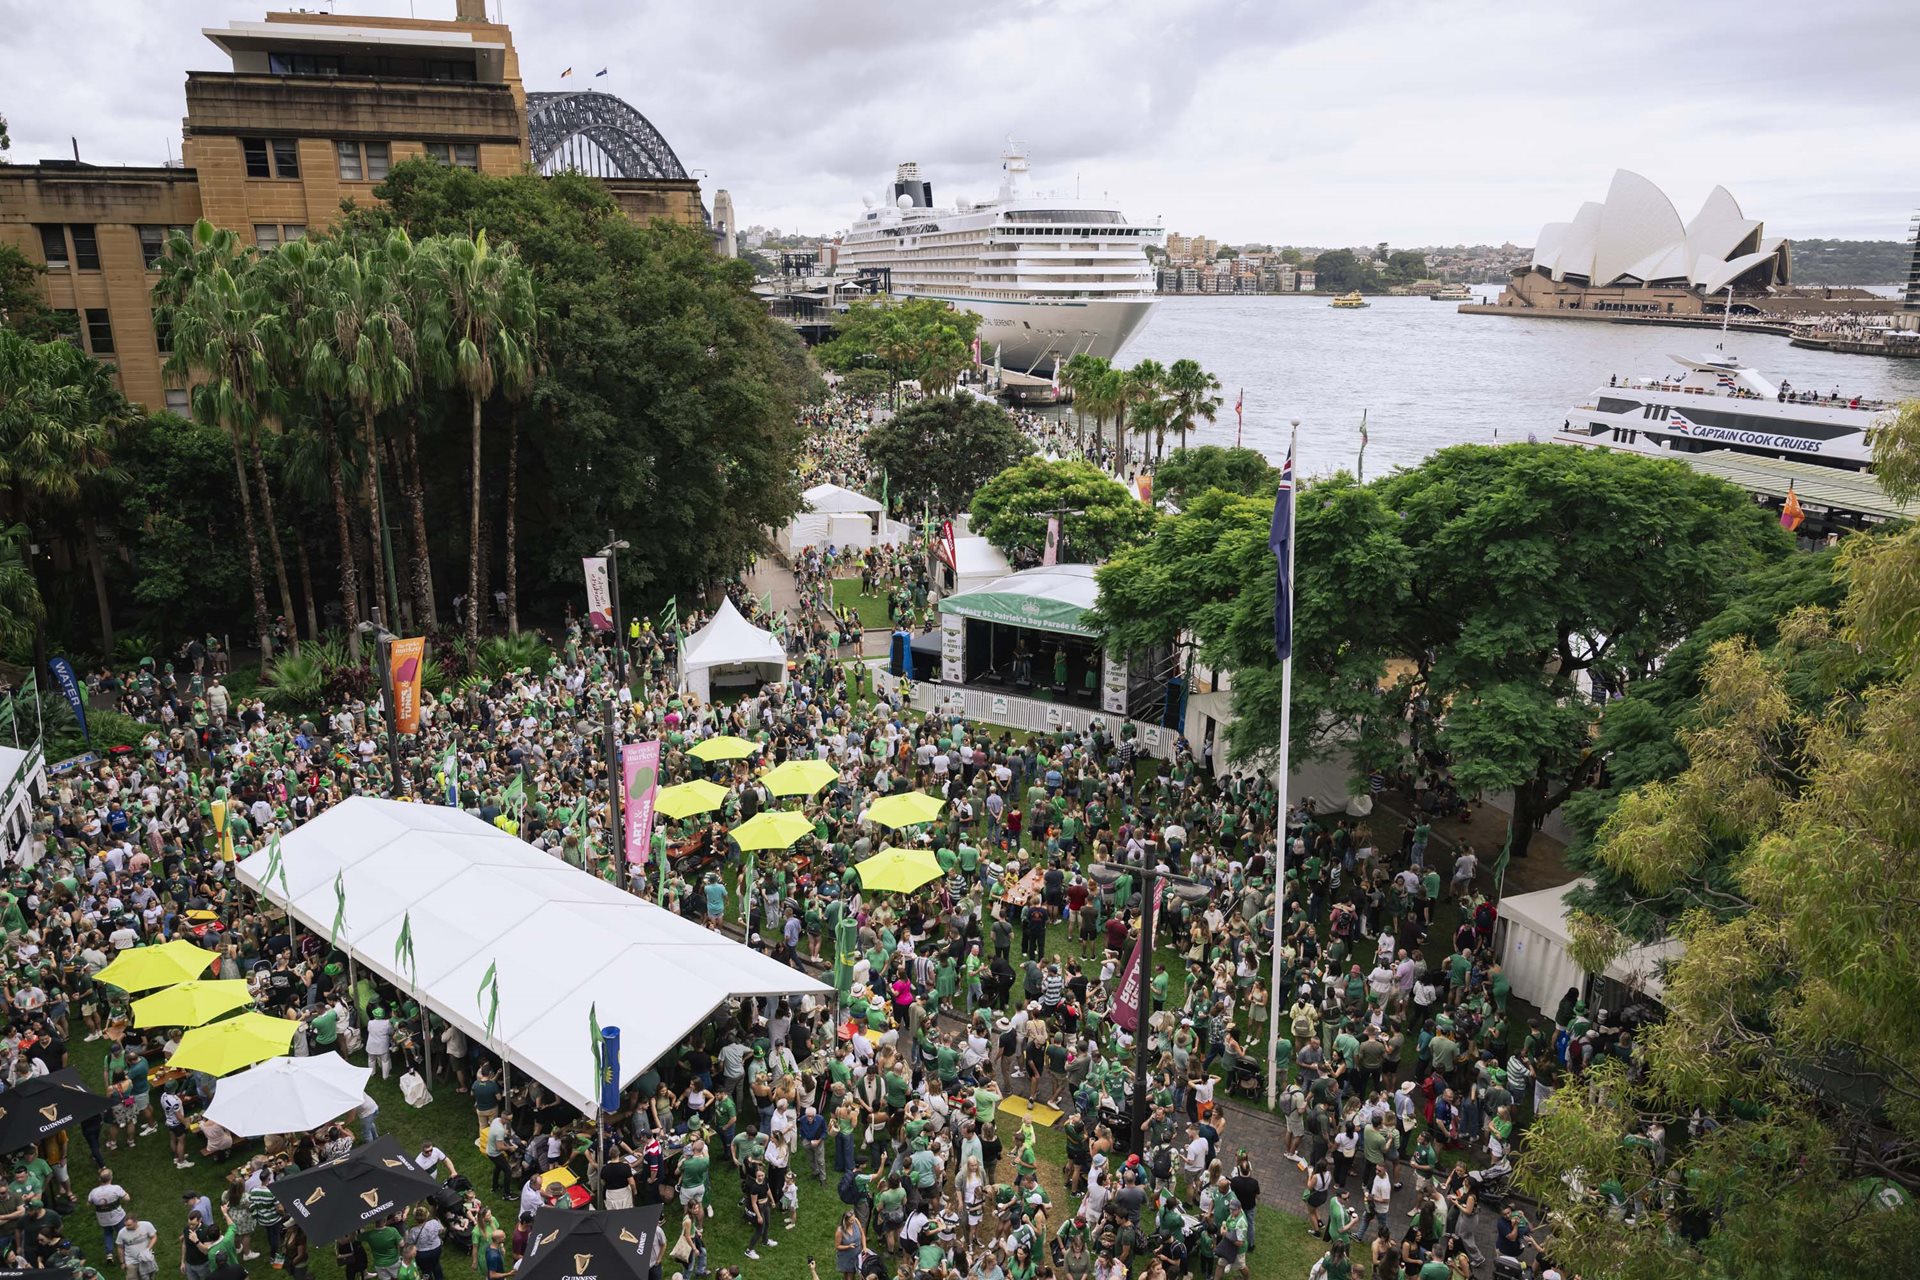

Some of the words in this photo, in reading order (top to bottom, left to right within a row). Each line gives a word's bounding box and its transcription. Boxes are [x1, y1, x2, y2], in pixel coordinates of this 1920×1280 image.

[1692, 426, 1739, 441] CAPTAIN
[1739, 434, 1774, 447] COOK
[1773, 436, 1823, 452] CRUISES
[956, 606, 982, 618] Sydney
[993, 612, 1027, 625] Patrick's
[1027, 616, 1042, 628] Day
[1043, 619, 1070, 631] Parade
[55, 661, 81, 706] WATER
[632, 821, 642, 847] ART
[39, 1114, 73, 1133] GUINNESS
[292, 1198, 311, 1218] GUINNESS
[360, 1200, 394, 1220] GUINNESS
